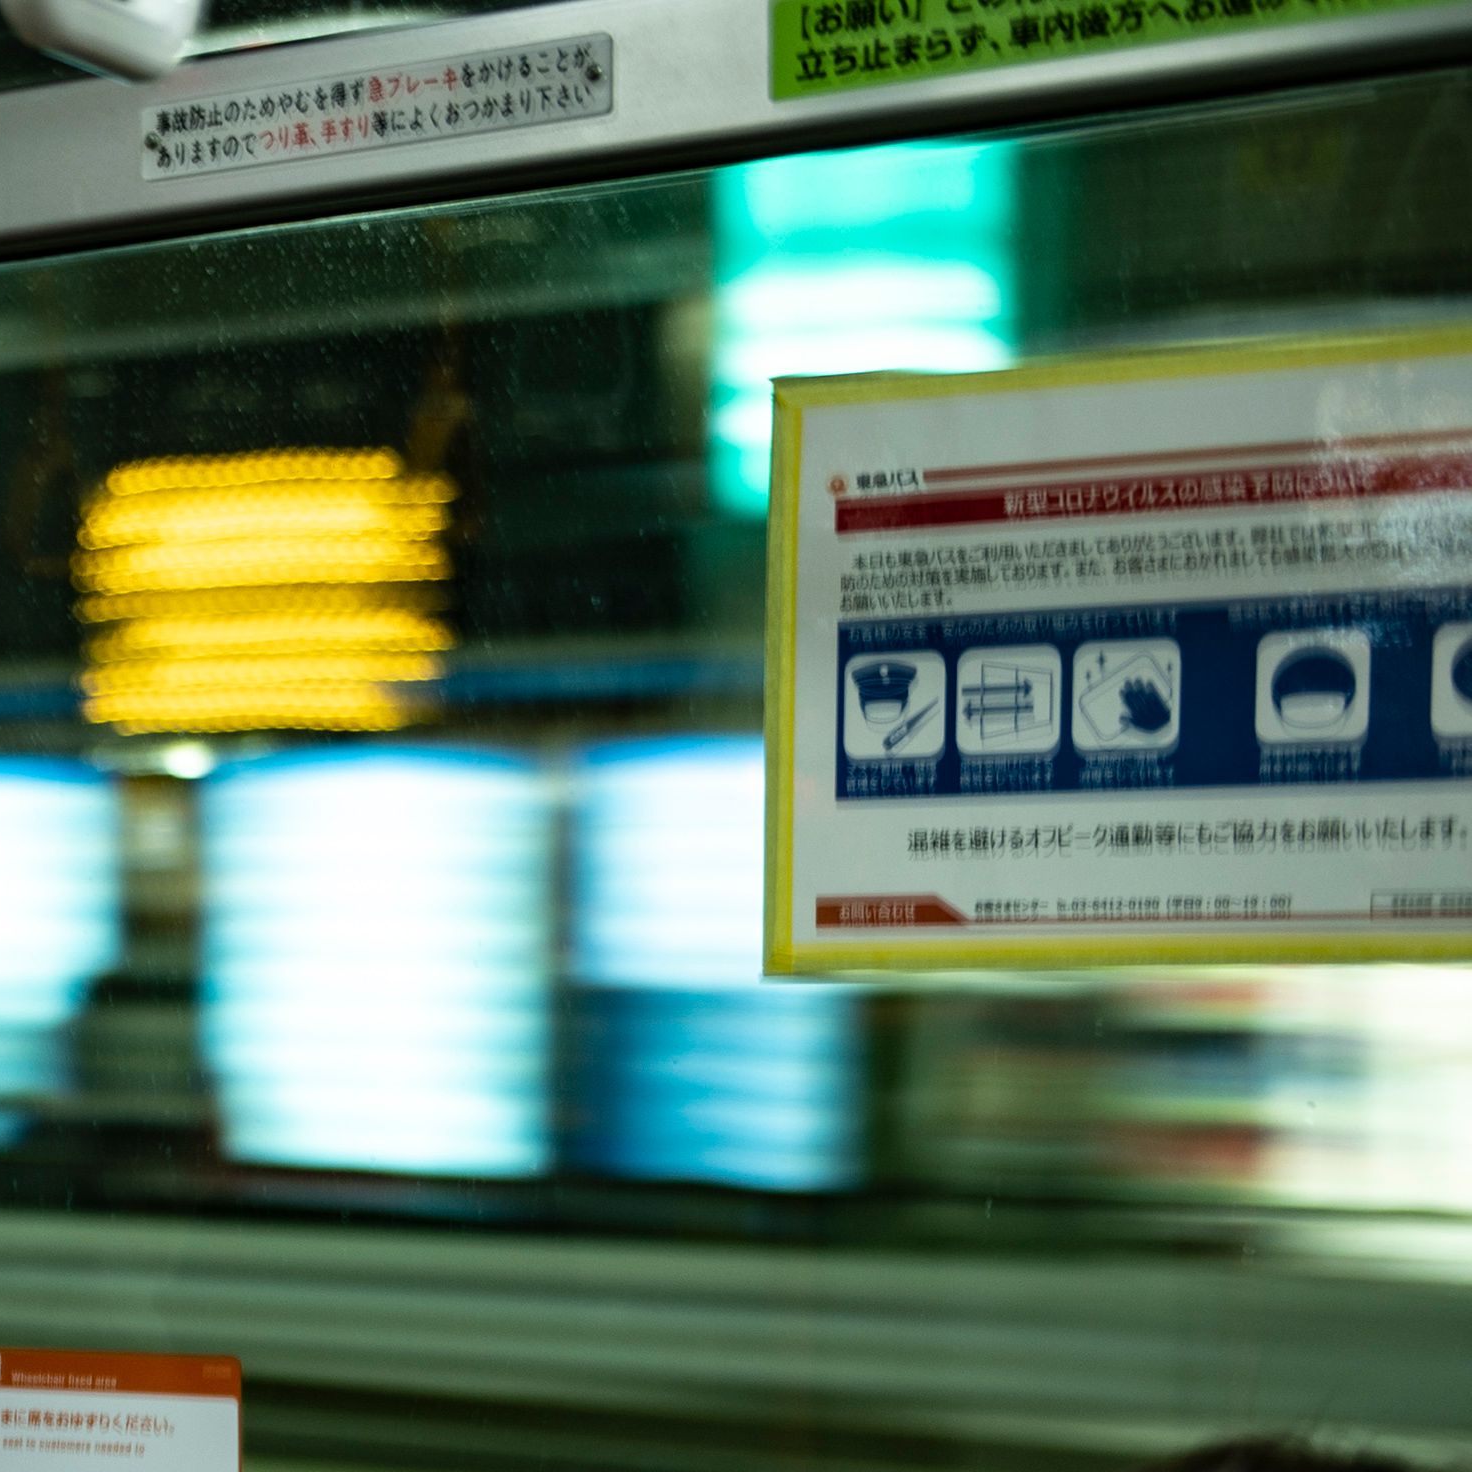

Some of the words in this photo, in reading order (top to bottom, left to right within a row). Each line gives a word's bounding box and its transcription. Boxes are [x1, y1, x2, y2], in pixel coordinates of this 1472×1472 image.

[156, 43, 592, 135] 事故防止のためやむを得ず急ブレーキをかけることが
[157, 86, 592, 168] ありますのでつり革、手すり等によくおつかまり下さい
[11, 1370, 66, 1388] Wheelchair
